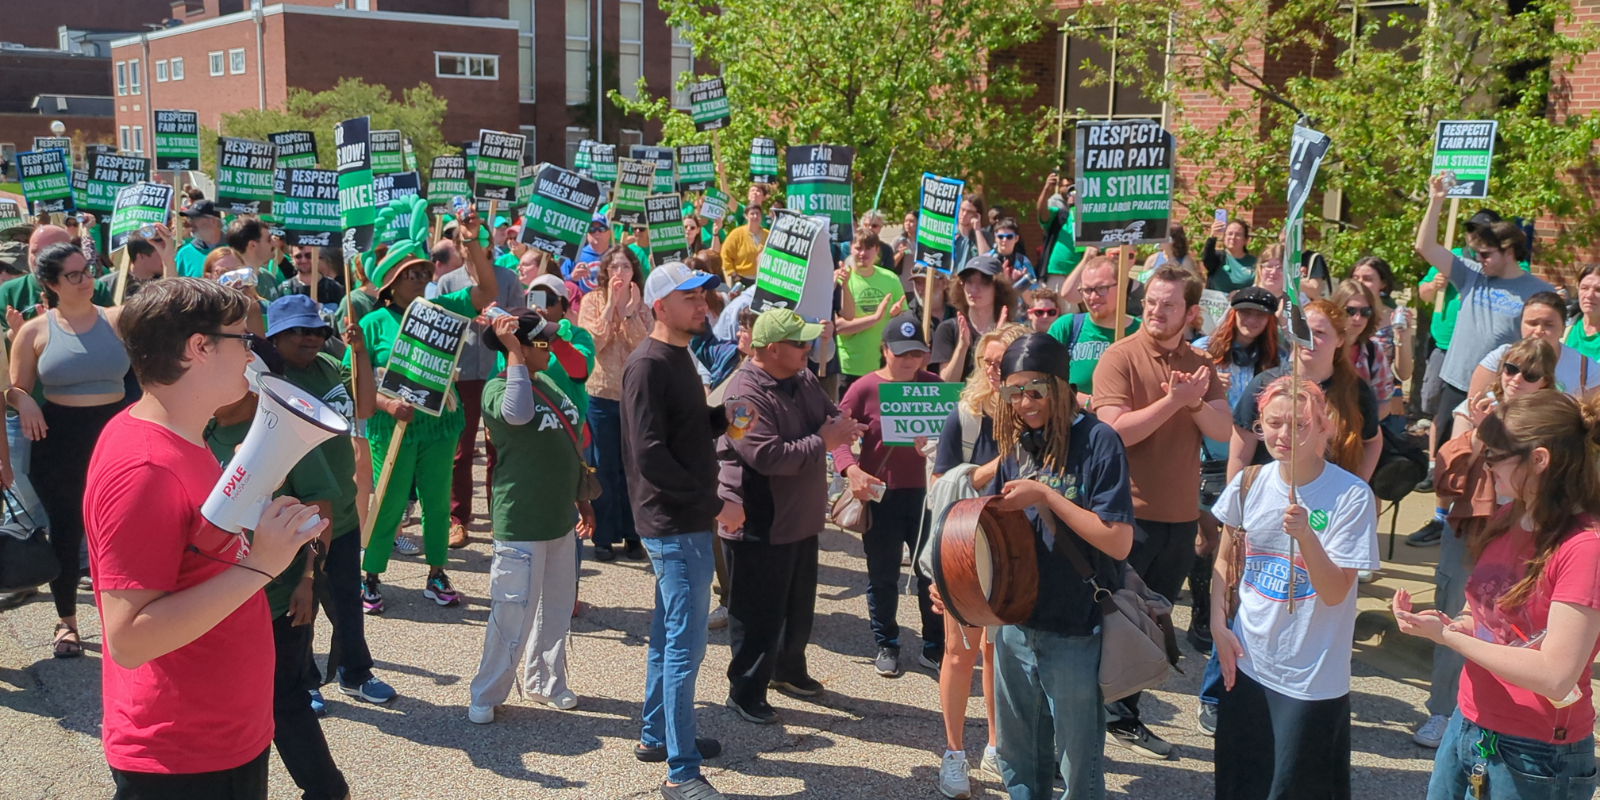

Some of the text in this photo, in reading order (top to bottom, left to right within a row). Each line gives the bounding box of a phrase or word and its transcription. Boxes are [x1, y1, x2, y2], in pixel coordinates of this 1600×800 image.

[693, 88, 724, 102] FAIR PAY!
[702, 97, 727, 111] STRIKE!
[158, 112, 195, 122] RESPECT!
[158, 122, 195, 133] FAIR PAY!
[1442, 124, 1490, 136] RESPECT!
[156, 136, 198, 147] ON STRIKE!
[275, 133, 310, 145] RESPECT!
[371, 133, 399, 142] RESPECT!
[484, 133, 521, 148] RESPECT!
[1088, 124, 1164, 146] RESPECT!
[224, 141, 272, 156] RESPECT!
[295, 142, 312, 153] PAY!
[371, 142, 399, 151] FAIR PAY!
[681, 145, 710, 154] RESPECT!
[1440, 136, 1489, 149] FAIR PAY!
[341, 142, 366, 163] NOW!
[482, 145, 499, 157] FAIR
[501, 148, 521, 160] PAY!
[645, 150, 660, 158] FAIR
[681, 153, 710, 163] FAIR PAY!
[762, 147, 775, 156] PAY!
[810, 147, 832, 161] FAIR
[1086, 147, 1165, 170] FAIR PAY!
[21, 152, 60, 166] RESPECT!
[96, 155, 145, 170] RESPECT!
[223, 154, 272, 170] FAIR PAY!
[288, 157, 316, 168] STRIKE!
[434, 157, 465, 168] RESPECT!
[1435, 154, 1488, 167] ON STRIKE!
[23, 162, 63, 176] FAIR PAY!
[432, 169, 447, 179] FAIR
[448, 169, 465, 179] PAY!
[478, 160, 517, 175] ON STRIKE
[623, 162, 653, 173] RESPECT!
[689, 164, 714, 173] STRIKE!
[792, 163, 849, 178] WAGES NOW!
[24, 180, 36, 191] ON
[37, 176, 69, 189] STRIKE!
[94, 169, 115, 181] FAIR
[121, 171, 145, 184] PAY!
[236, 171, 274, 187] STRIKE!
[374, 177, 394, 189] FAIR
[557, 172, 580, 189] FAIR
[620, 173, 636, 184] FAIR
[654, 175, 673, 185] RIKE!
[87, 183, 103, 196] ON
[122, 184, 166, 197] RESPECT!
[291, 184, 314, 197] FAIR
[437, 181, 467, 193] STRIKE!
[538, 178, 572, 199] WAGES
[569, 190, 596, 207] NOW!
[1106, 174, 1171, 198] STRIKE!
[118, 196, 142, 208] FAIR
[143, 195, 165, 208] PAY!
[373, 190, 389, 203] GES
[648, 197, 678, 210] RESPECT!
[787, 193, 851, 211] ON STRIKE!
[285, 201, 341, 217] ON STRIKE
[934, 198, 956, 215] PAY!
[1082, 203, 1107, 214] NFAIR
[1108, 201, 1131, 212] LABOR
[127, 209, 164, 222] STRIKE!
[526, 202, 590, 236] ON STRIKE!
[649, 209, 664, 222] FAIR
[665, 208, 680, 220] PAY!
[660, 225, 685, 238] STRIKE!
[1101, 231, 1144, 243] AFSCME
[532, 240, 563, 255] AFSCME
[768, 229, 810, 256] FAIR PAY!
[760, 253, 806, 282] ON STRIKE!
[411, 302, 463, 334] RESPECT!
[404, 317, 459, 352] FAIR PAY!
[394, 338, 454, 376] ON STRIKE!
[1072, 341, 1110, 362] NOTRE
[397, 388, 427, 406] AFSCME
[902, 385, 941, 396] FAIR
[880, 401, 955, 413] CONTRAC
[893, 419, 946, 434] NOW
[222, 464, 247, 498] PYLE
